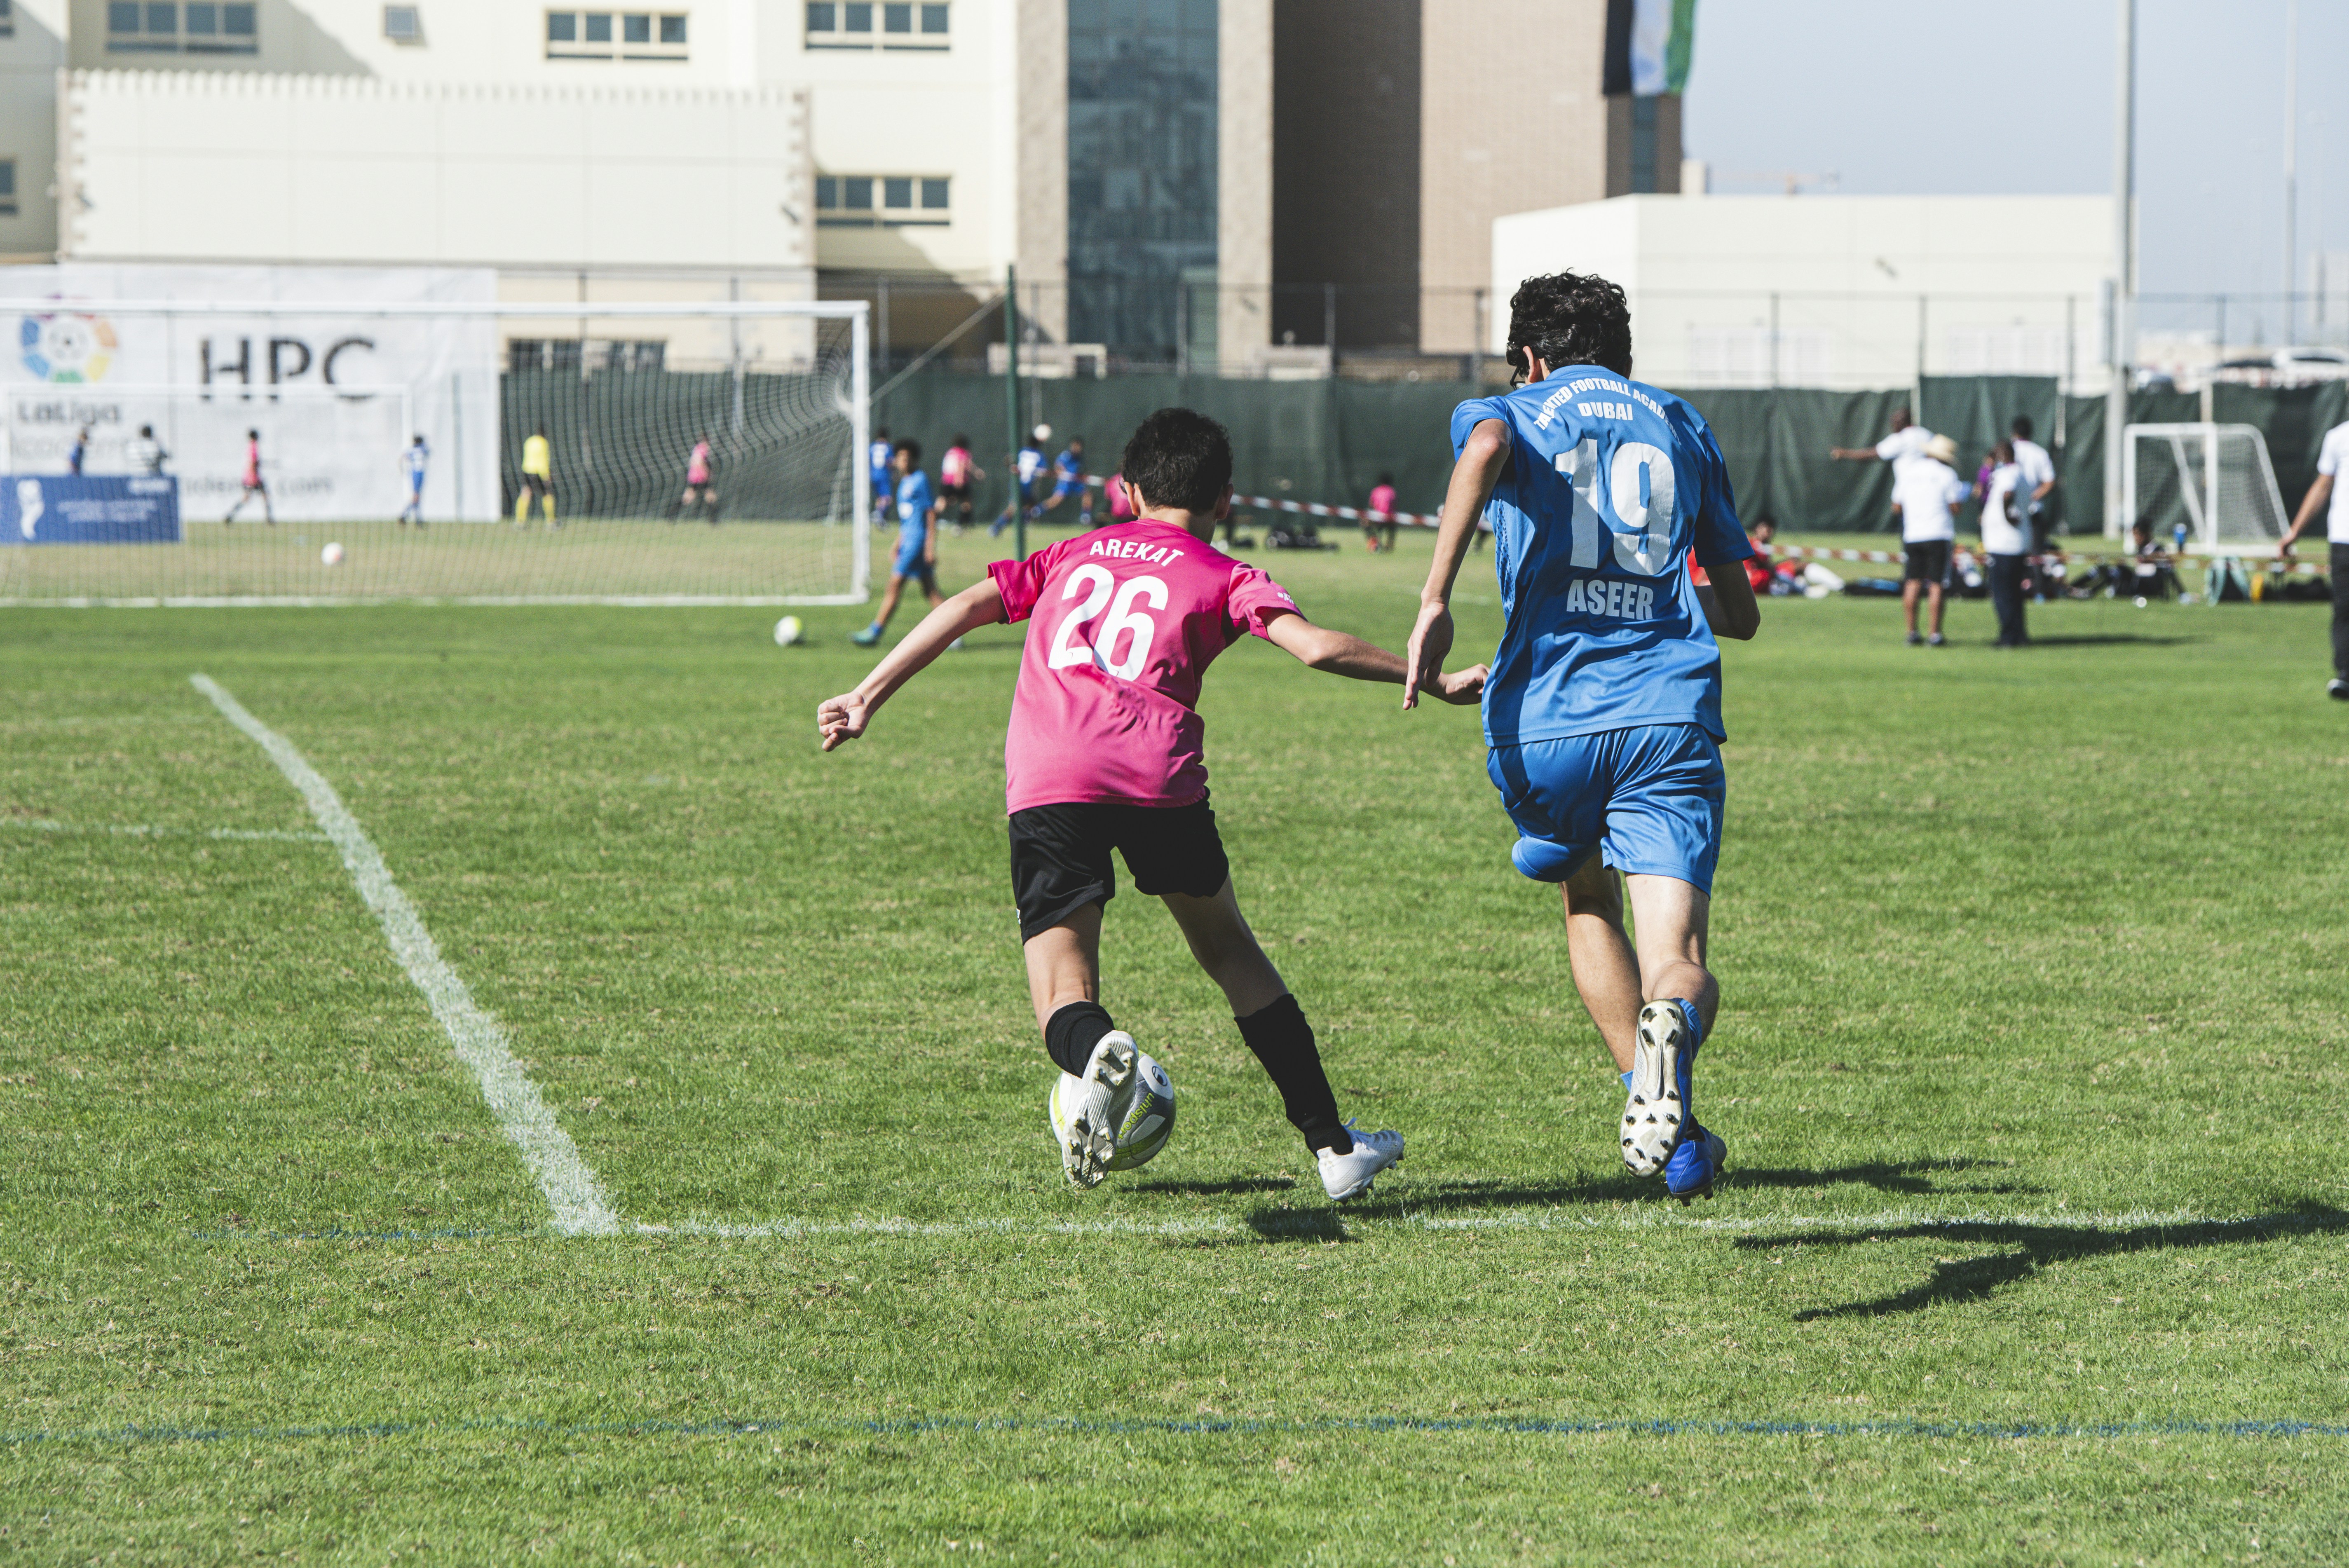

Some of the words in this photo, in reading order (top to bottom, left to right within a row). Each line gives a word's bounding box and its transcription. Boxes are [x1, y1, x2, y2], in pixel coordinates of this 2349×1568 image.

[201, 337, 376, 401] HPC
[1569, 378, 1631, 396] FOOTBALL
[1577, 402, 1633, 421] DUBAI
[1555, 438, 1674, 575] 19
[1089, 539, 1185, 567] AREKAT
[1566, 579, 1653, 620] ASEER
[1048, 563, 1169, 682] 26
[1118, 1092, 1155, 1139] uhlsport
